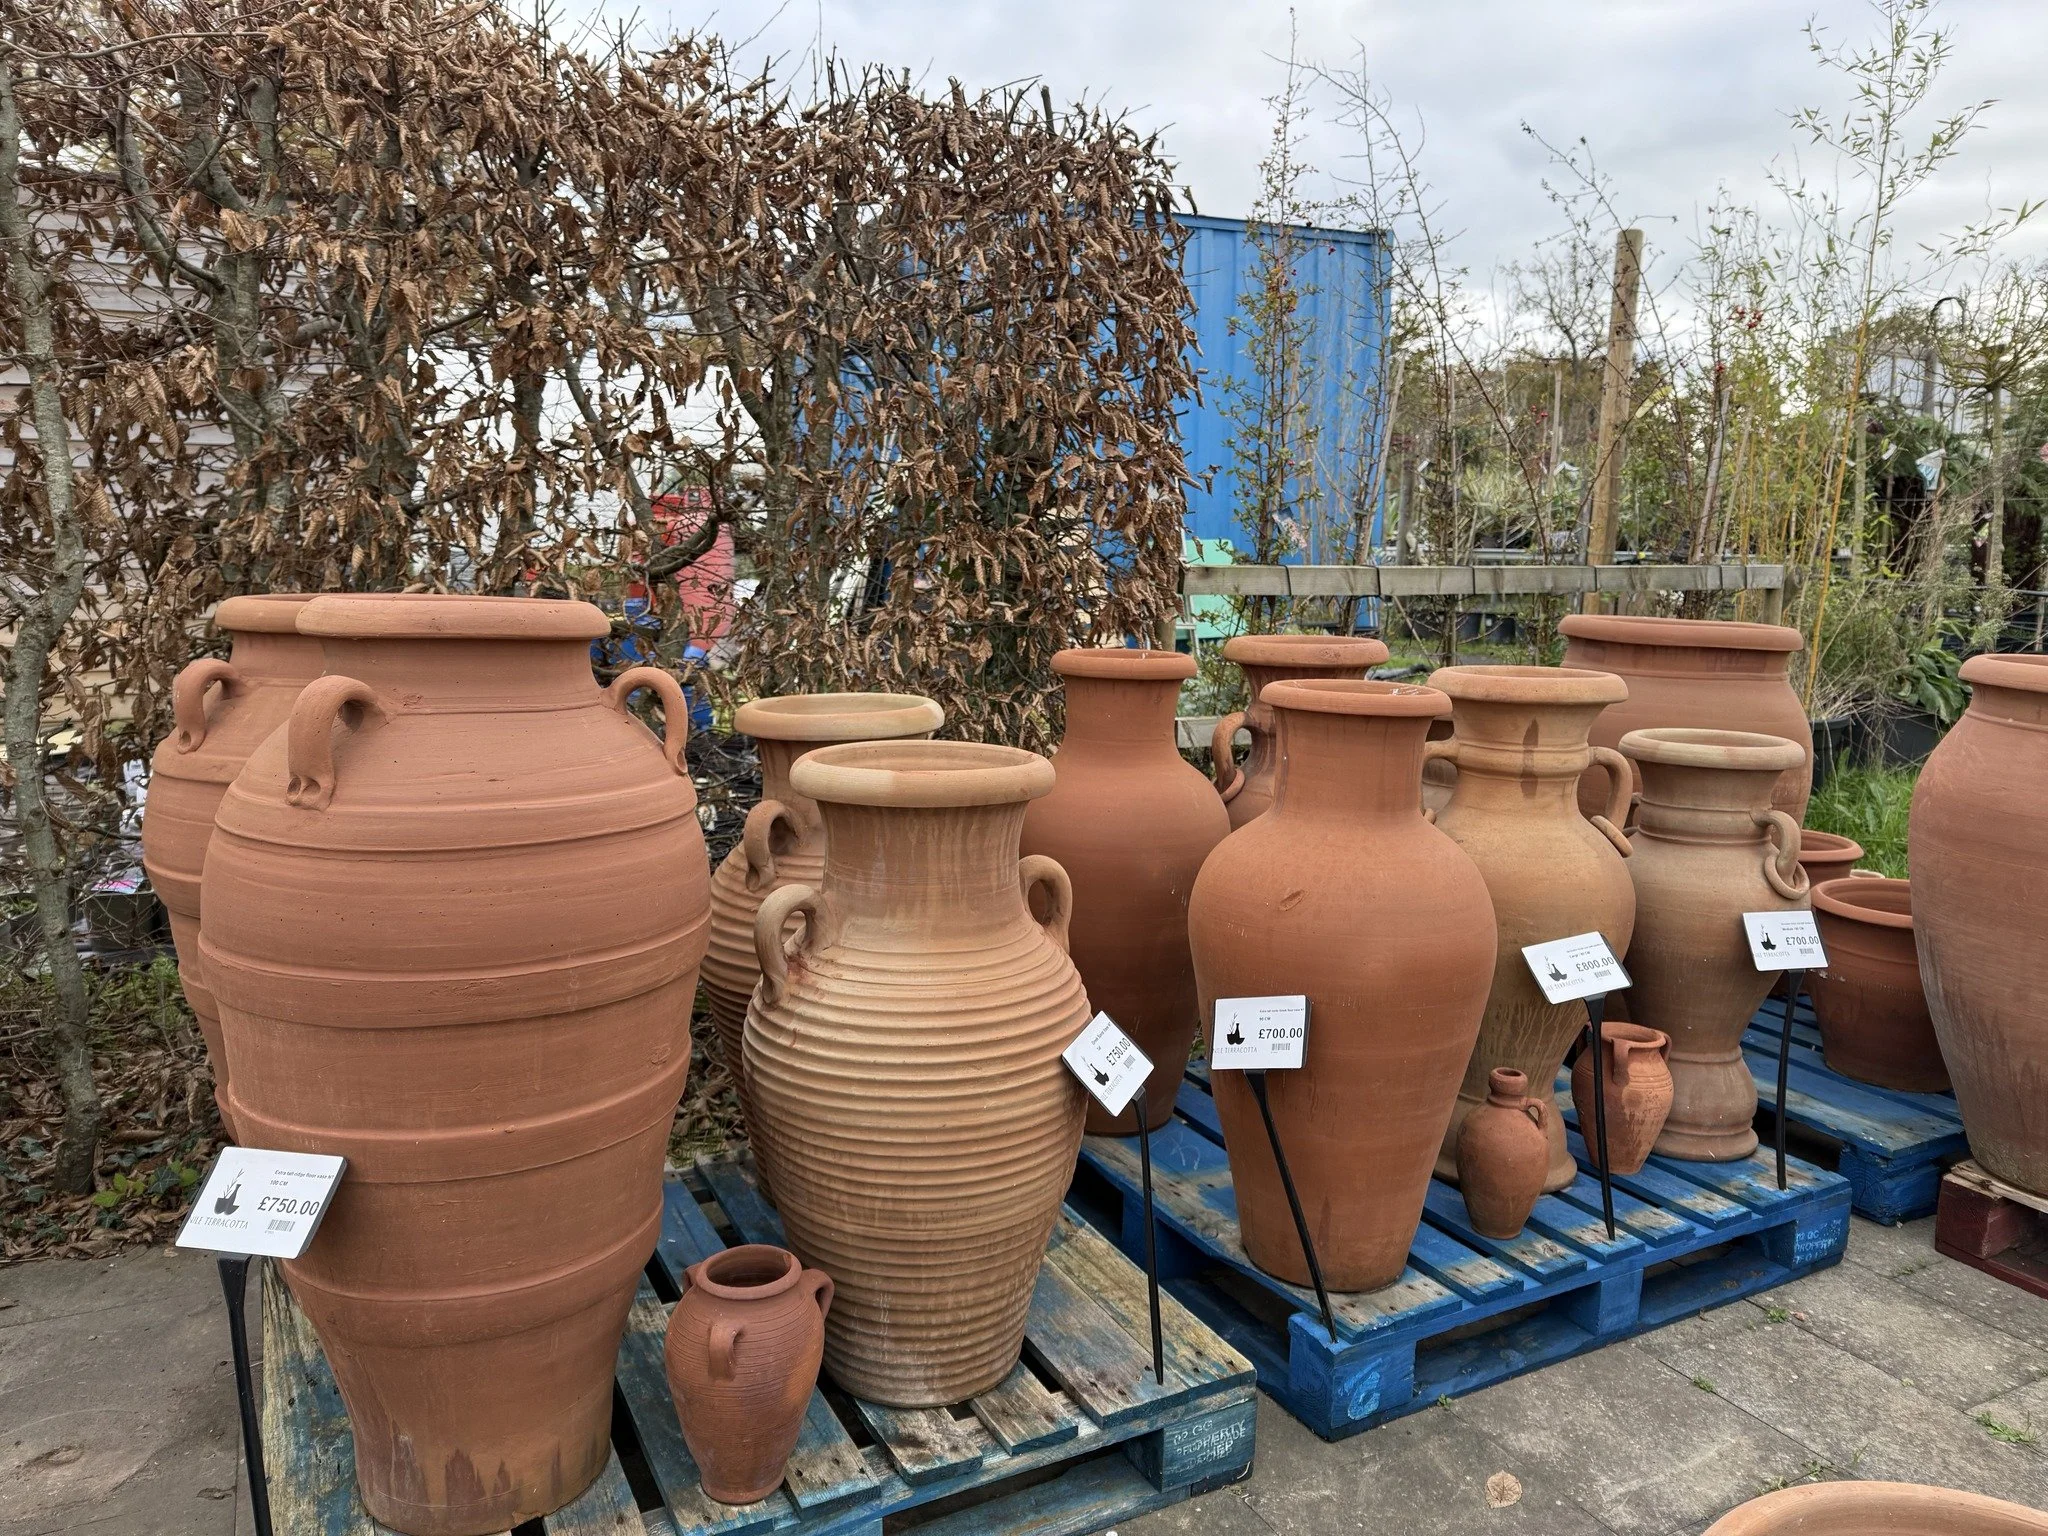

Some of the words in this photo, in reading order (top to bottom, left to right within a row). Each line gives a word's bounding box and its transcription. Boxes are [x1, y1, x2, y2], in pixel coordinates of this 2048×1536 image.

[1785, 935, 1820, 946] £700.00
[1575, 956, 1615, 972] £800.00
[1258, 1027, 1303, 1039] £700.00
[1105, 1037, 1131, 1066] £750.00
[257, 1196, 320, 1216] £750.00
[204, 1216, 249, 1230] TERRACOTTA
